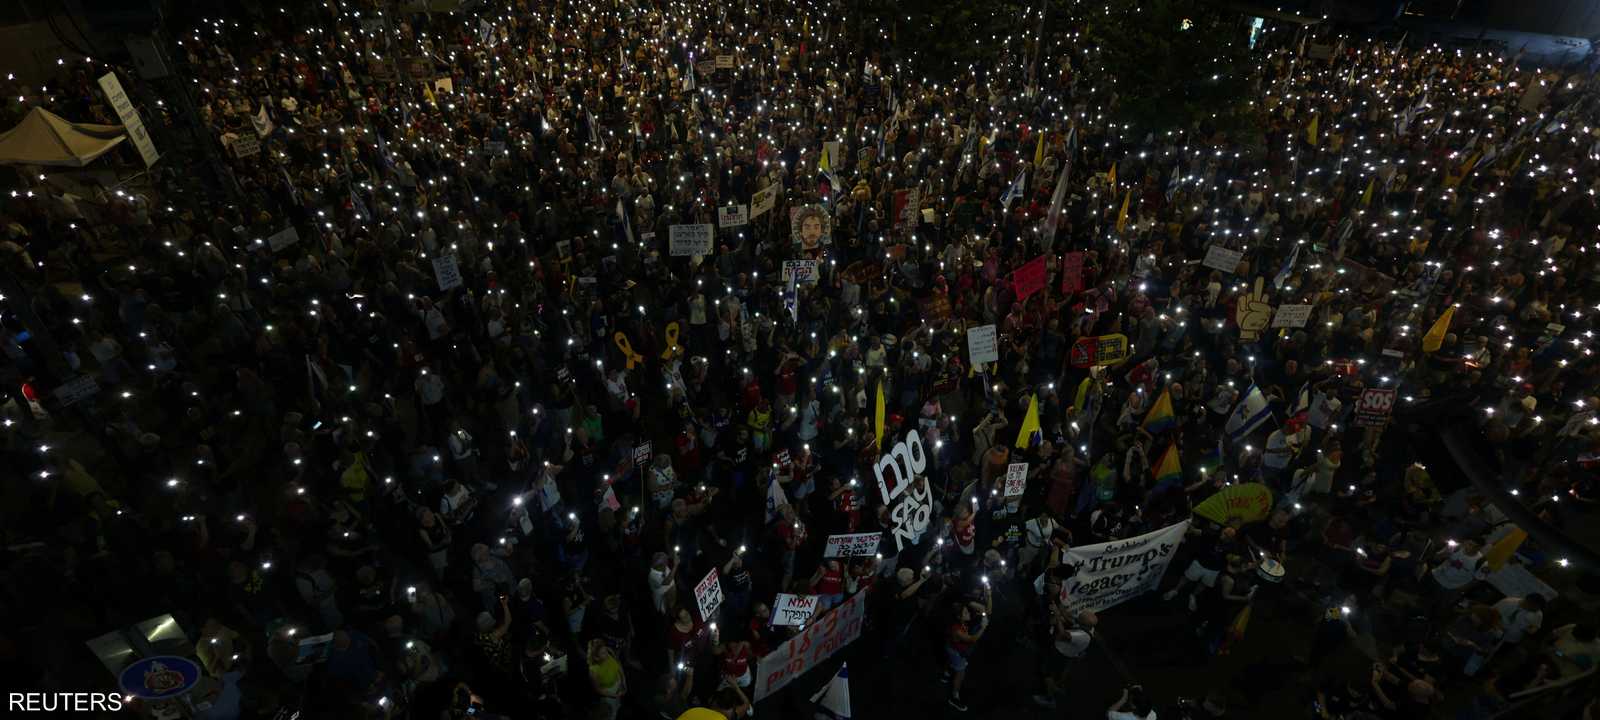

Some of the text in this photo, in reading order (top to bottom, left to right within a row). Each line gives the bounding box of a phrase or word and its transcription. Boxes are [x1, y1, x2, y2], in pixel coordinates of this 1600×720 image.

[1362, 391, 1392, 410] SOS
[891, 475, 933, 534] SAY
[893, 504, 930, 552] NO
[788, 598, 813, 608] אמא
[782, 608, 812, 622] בתפקיד
